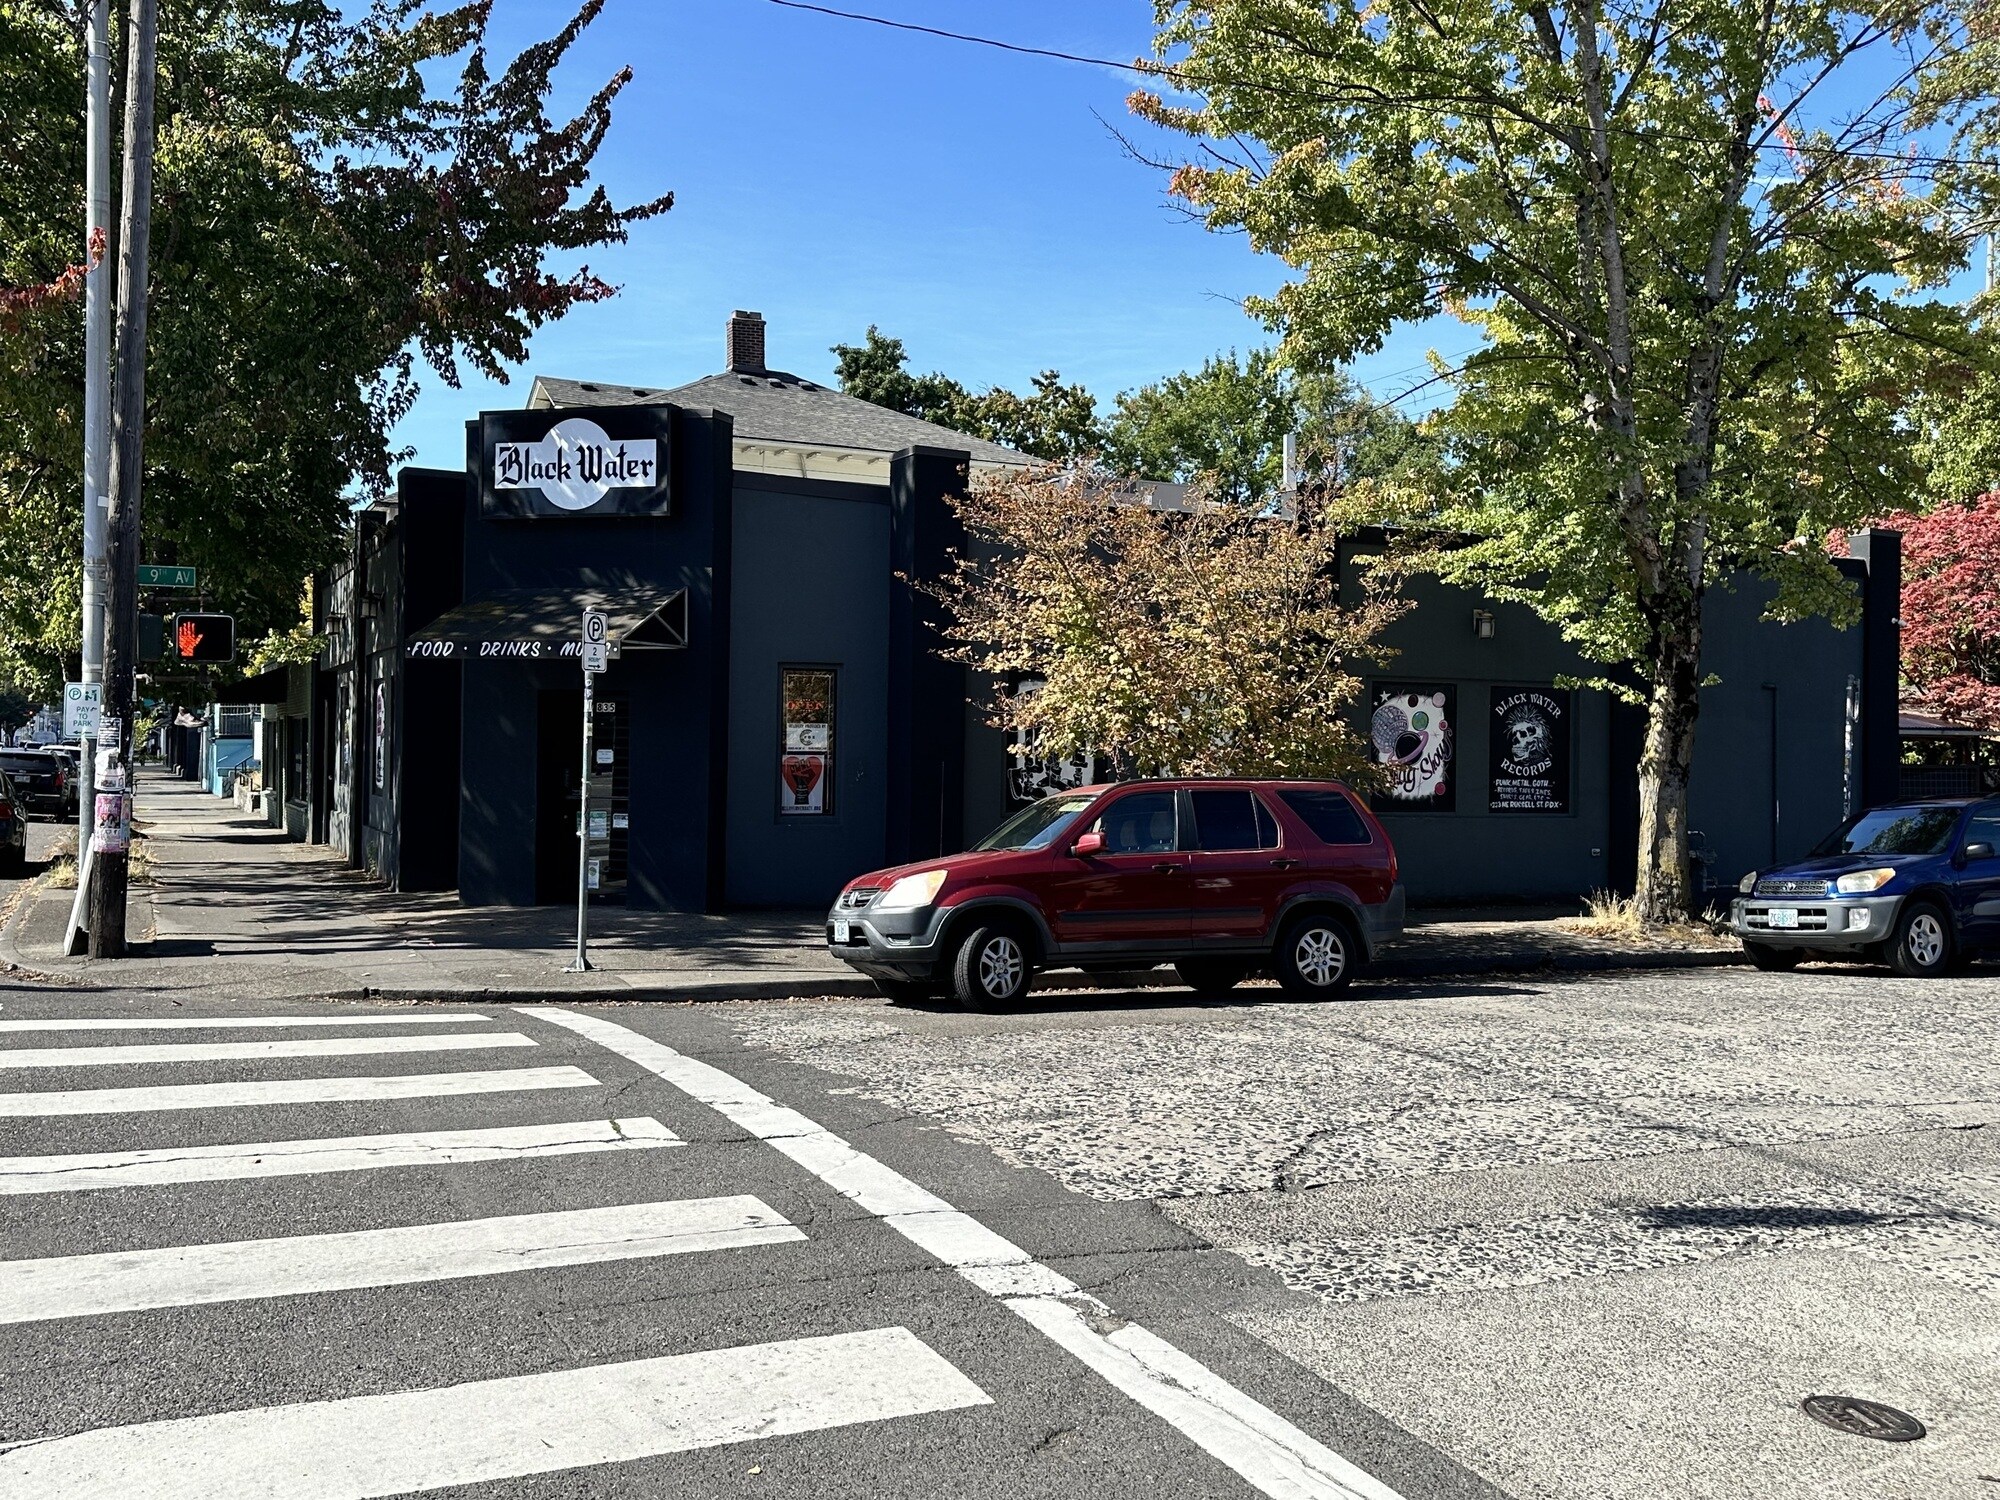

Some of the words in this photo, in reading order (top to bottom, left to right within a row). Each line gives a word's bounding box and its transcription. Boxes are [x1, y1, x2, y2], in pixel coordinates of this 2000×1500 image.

[497, 444, 571, 486] Black
[575, 443, 654, 484] Water
[150, 569, 168, 582] 9TH
[175, 570, 190, 584] AV
[411, 641, 455, 657] FOOD
[479, 641, 541, 657] DRINKS
[593, 647, 598, 656] 2
[597, 703, 615, 712] 835
[1495, 693, 1527, 716] BLACK
[1530, 693, 1562, 719] WATER
[1500, 758, 1552, 776] RECORDS
